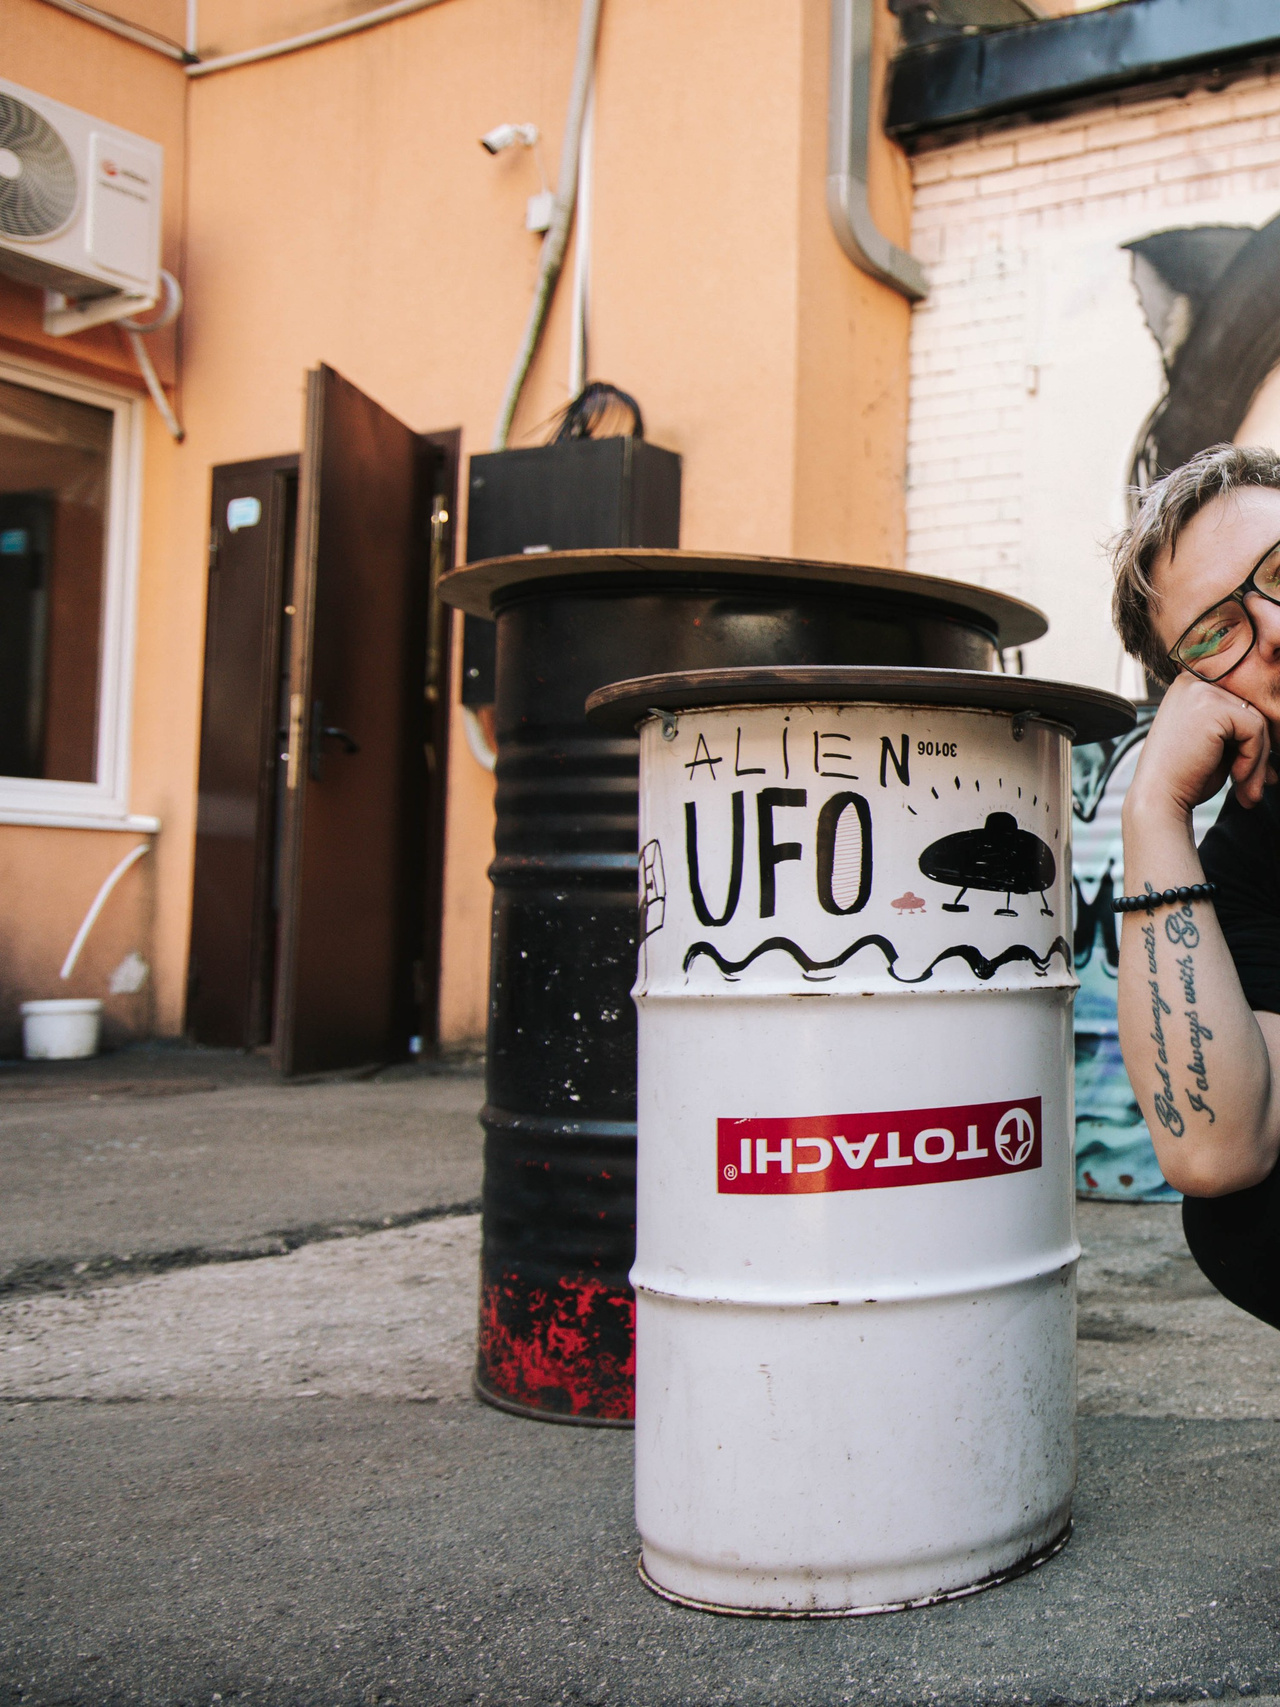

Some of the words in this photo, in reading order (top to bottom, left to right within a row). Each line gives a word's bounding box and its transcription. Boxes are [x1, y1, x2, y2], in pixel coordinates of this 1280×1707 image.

[917, 741, 957, 758] 30106
[684, 787, 873, 927] UFO
[1141, 922, 1158, 974] with
[1165, 887, 1200, 949] Go
[1176, 954, 1198, 1005] with
[1149, 981, 1171, 1063] always
[1183, 1011, 1213, 1092] always
[1155, 1062, 1185, 1138] God
